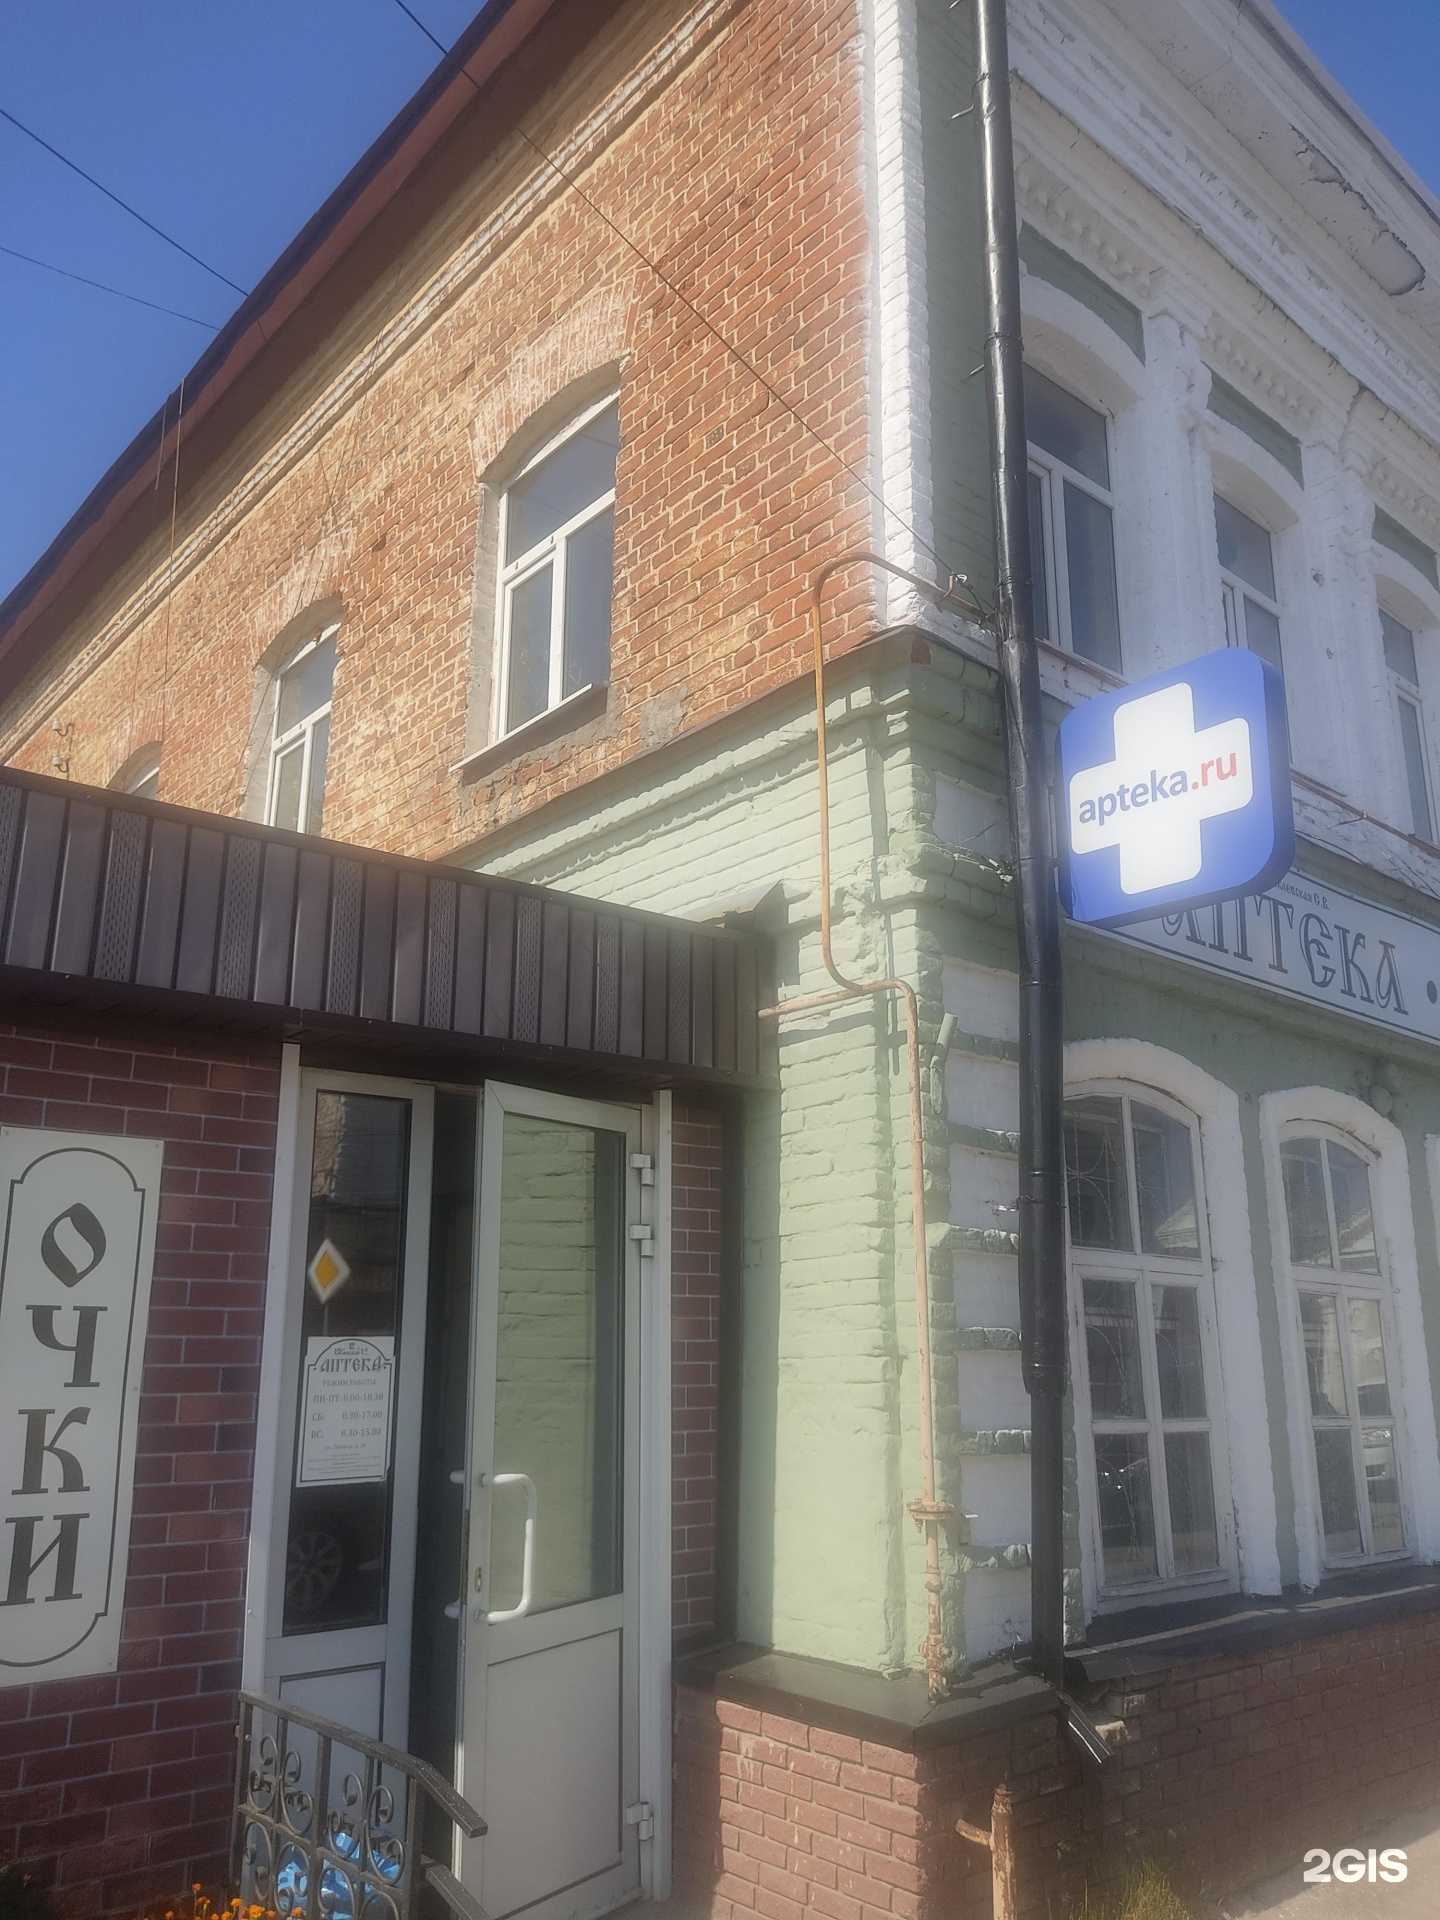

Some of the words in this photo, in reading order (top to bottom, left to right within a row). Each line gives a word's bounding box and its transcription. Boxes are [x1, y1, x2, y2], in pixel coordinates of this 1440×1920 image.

[1078, 751, 1239, 826] apteka.ru
[320, 1356, 382, 1373] АПТЕКА
[0, 1203, 108, 1606] ОЧКИ
